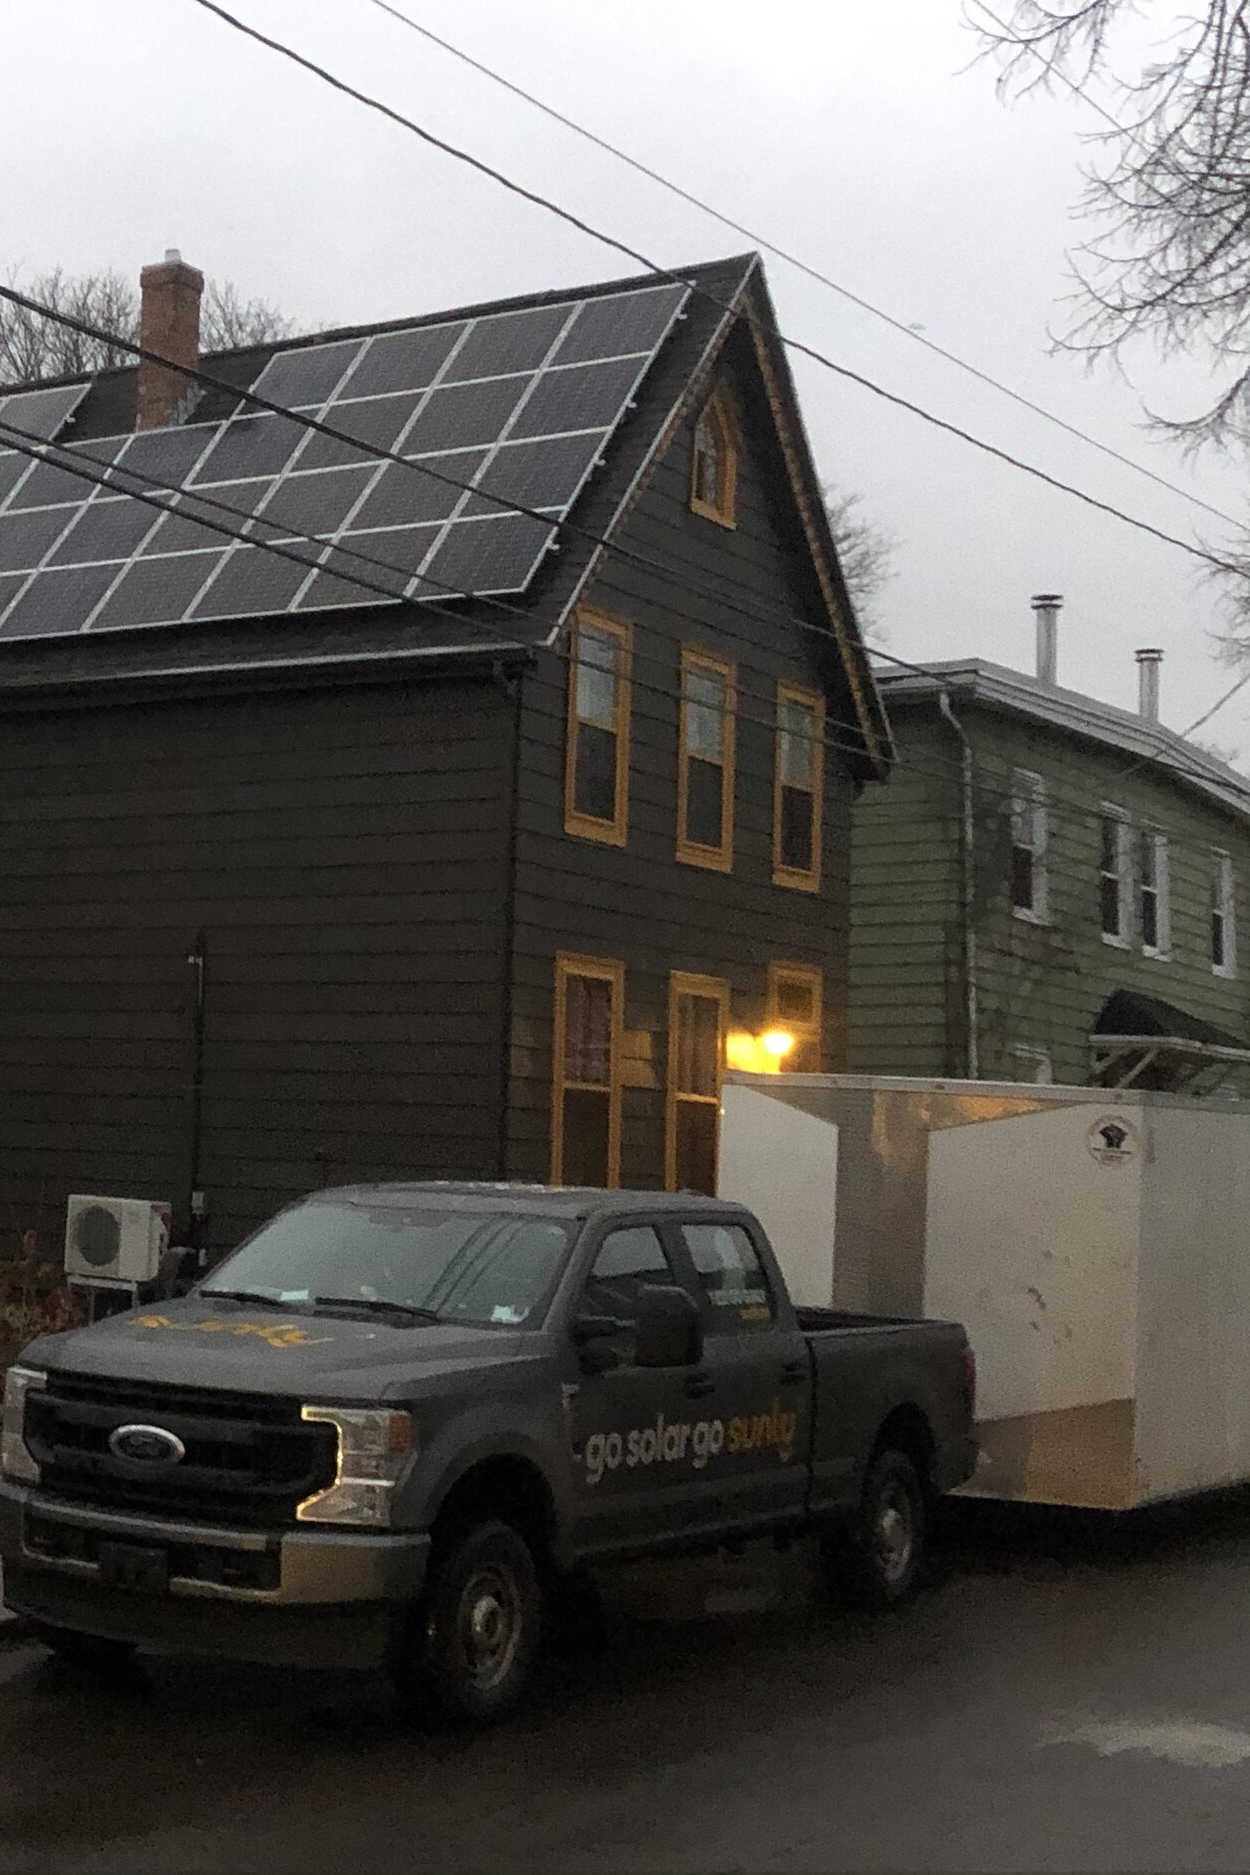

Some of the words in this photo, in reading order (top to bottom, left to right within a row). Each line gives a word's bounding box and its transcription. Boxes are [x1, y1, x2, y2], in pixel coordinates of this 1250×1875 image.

[586, 1433, 622, 1484] go
[627, 1412, 691, 1467] solar
[692, 1419, 724, 1469] go
